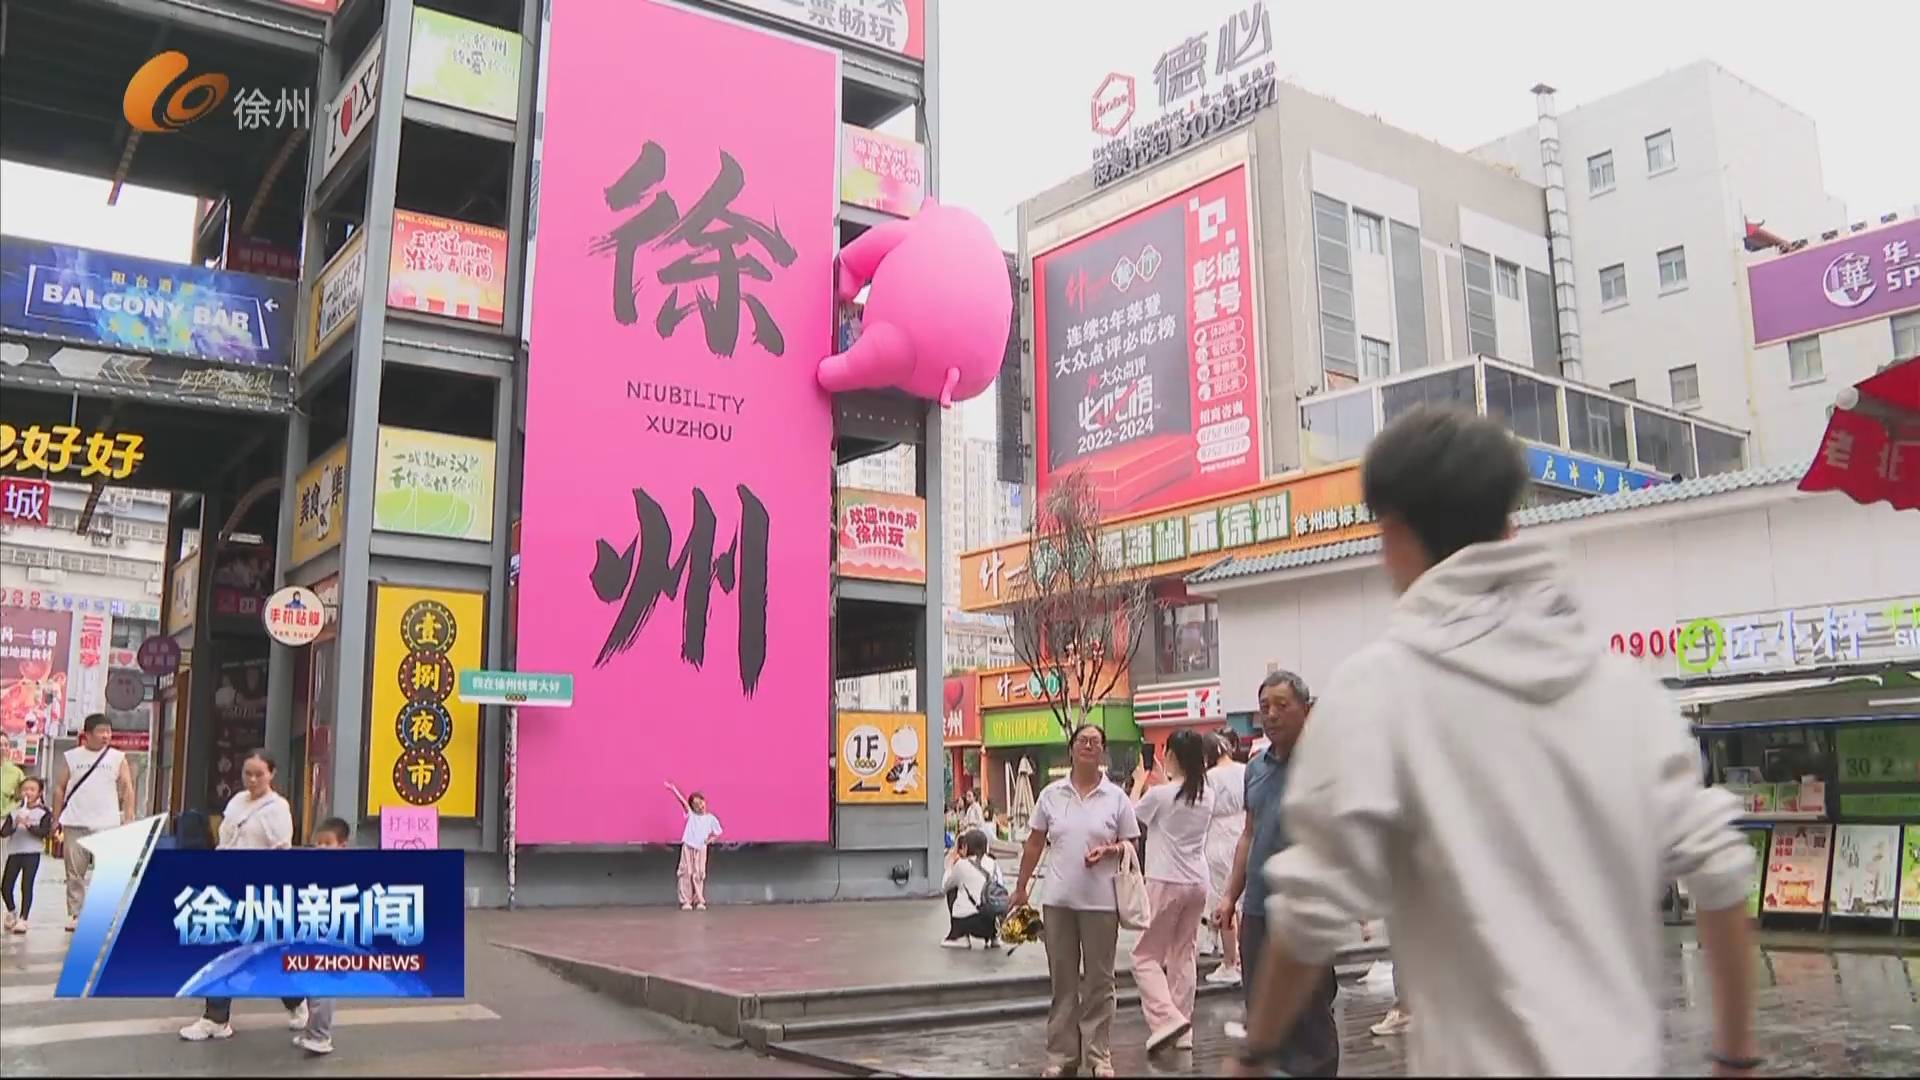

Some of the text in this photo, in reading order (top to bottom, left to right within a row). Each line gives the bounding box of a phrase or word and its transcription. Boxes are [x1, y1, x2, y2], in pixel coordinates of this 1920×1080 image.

[1153, 1, 1273, 107] 德必
[586, 140, 798, 358] 徐
[1882, 240, 1920, 263] 华
[42, 282, 186, 319] BALCONY
[193, 306, 250, 331] BAR
[1066, 292, 1161, 348] 连续3年荣登
[1054, 315, 1177, 379] 大众点评必吃榜
[1099, 355, 1147, 389] 大众点评
[627, 380, 745, 415] NIUBILITY
[646, 415, 733, 443] XUZHOU
[1078, 414, 1155, 455] 2022-2024
[4, 484, 45, 520] 城
[855, 525, 905, 549] 徐州玩
[589, 483, 770, 701] 州
[405, 611, 442, 792] 壹捌夜市
[853, 734, 879, 759] 1F
[389, 815, 430, 832] 打卡区
